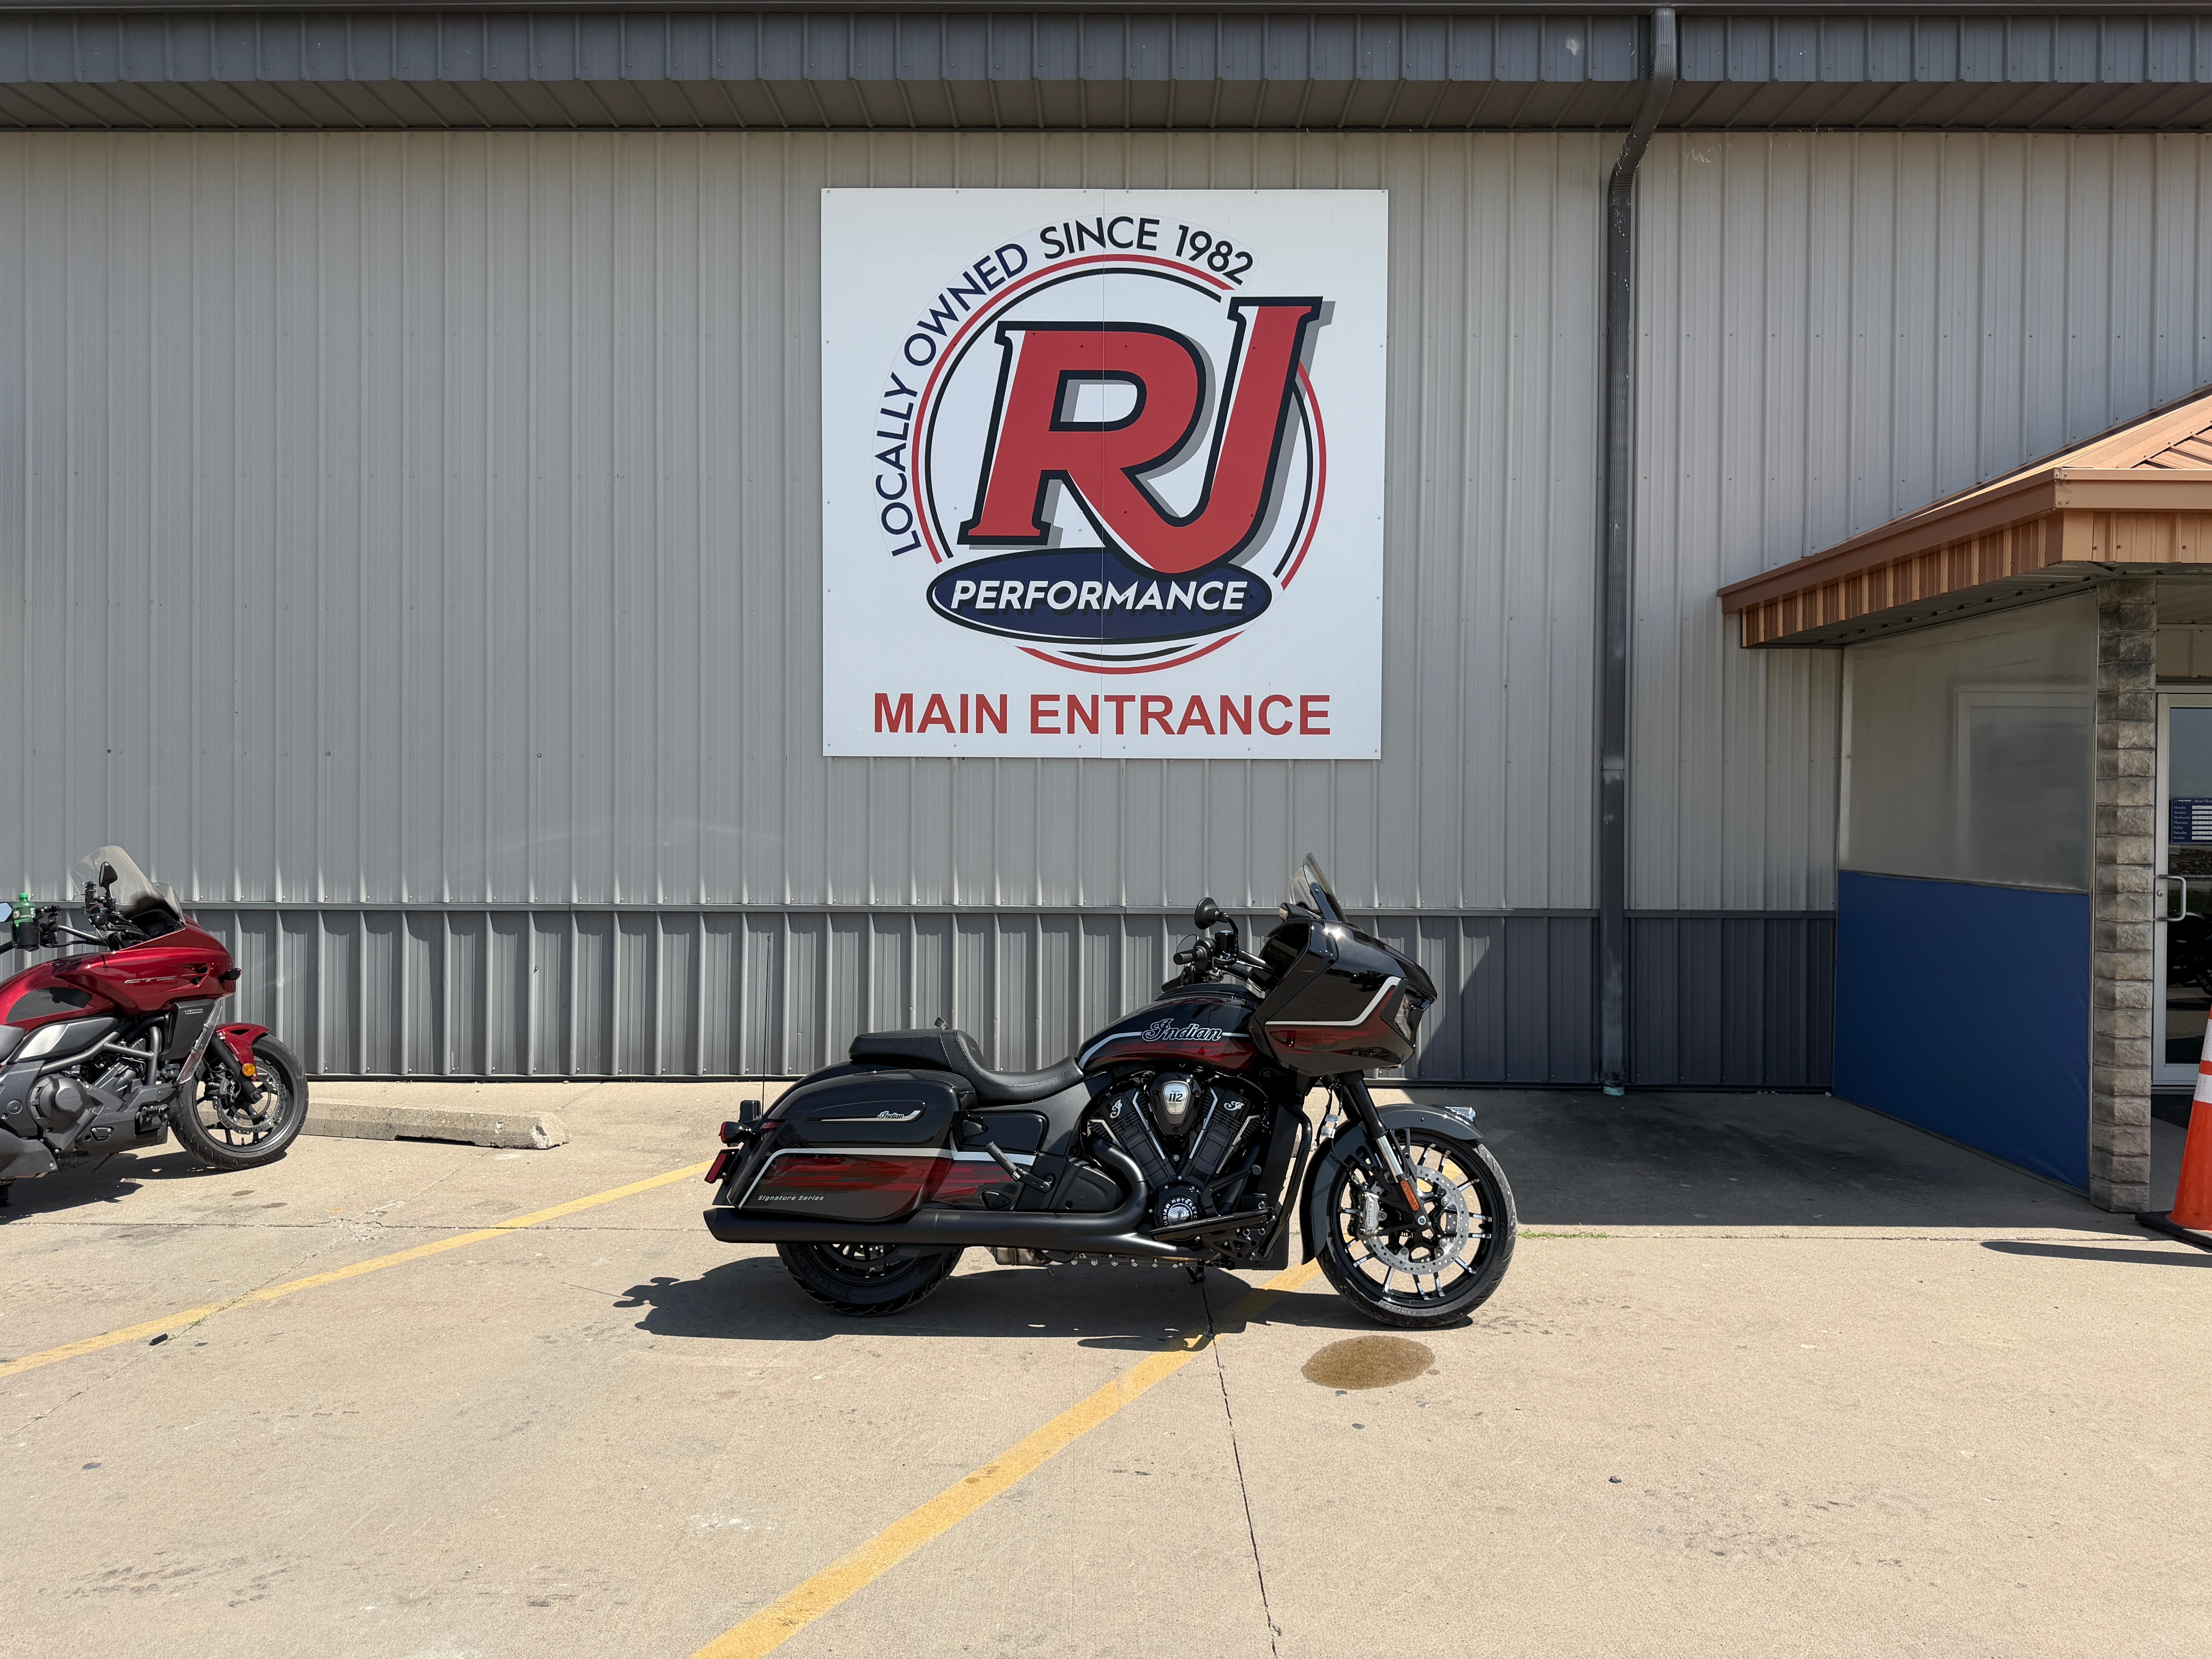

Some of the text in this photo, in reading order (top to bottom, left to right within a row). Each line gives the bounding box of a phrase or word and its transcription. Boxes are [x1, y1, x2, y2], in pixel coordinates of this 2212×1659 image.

[874, 216, 1254, 557] LOCALLY OWNED SINCE 1982
[957, 295, 1324, 579] RJ
[950, 580, 1248, 611] PERFORMANCE
[874, 693, 1331, 735] MAIN ENTRANCE
[1142, 1018, 1223, 1042] Indian
[1168, 1093, 1183, 1102] 112
[877, 1110, 905, 1119] Indian
[1163, 1198, 1198, 1226] NDIAN MOTORCYC
[794, 1251, 847, 1297] METZELER
